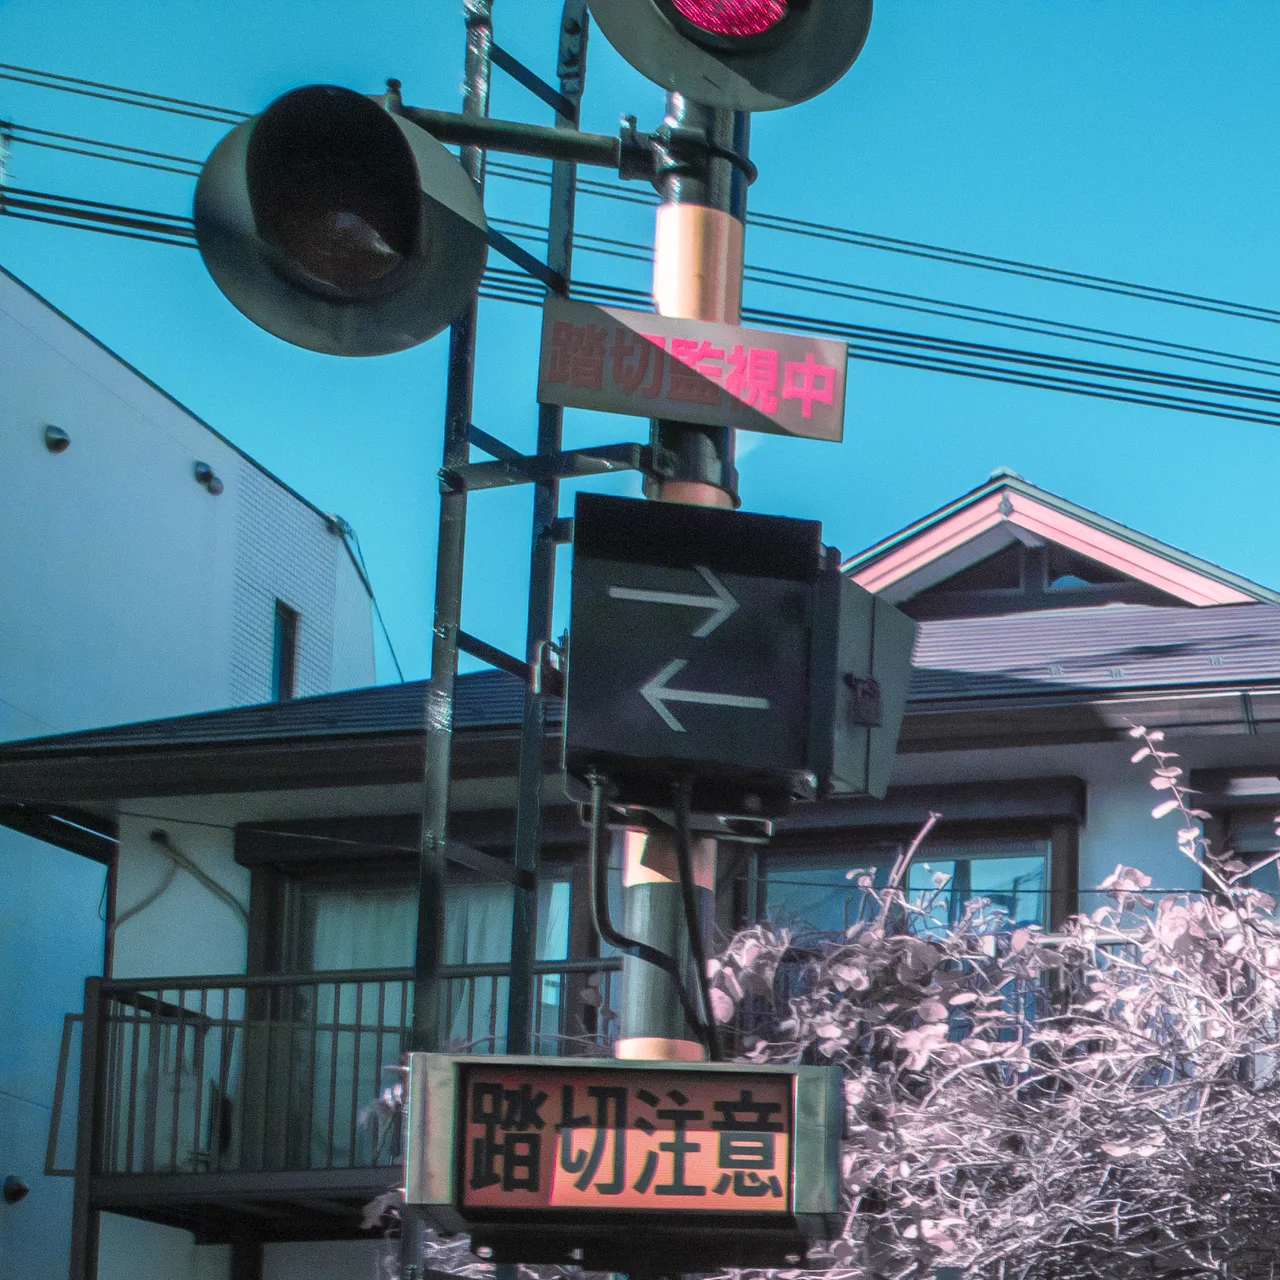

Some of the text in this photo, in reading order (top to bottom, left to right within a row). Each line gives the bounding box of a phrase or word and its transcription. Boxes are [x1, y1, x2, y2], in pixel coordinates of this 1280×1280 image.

[547, 320, 838, 419] 踏切監視中
[468, 1082, 785, 1199] 踏切注意
